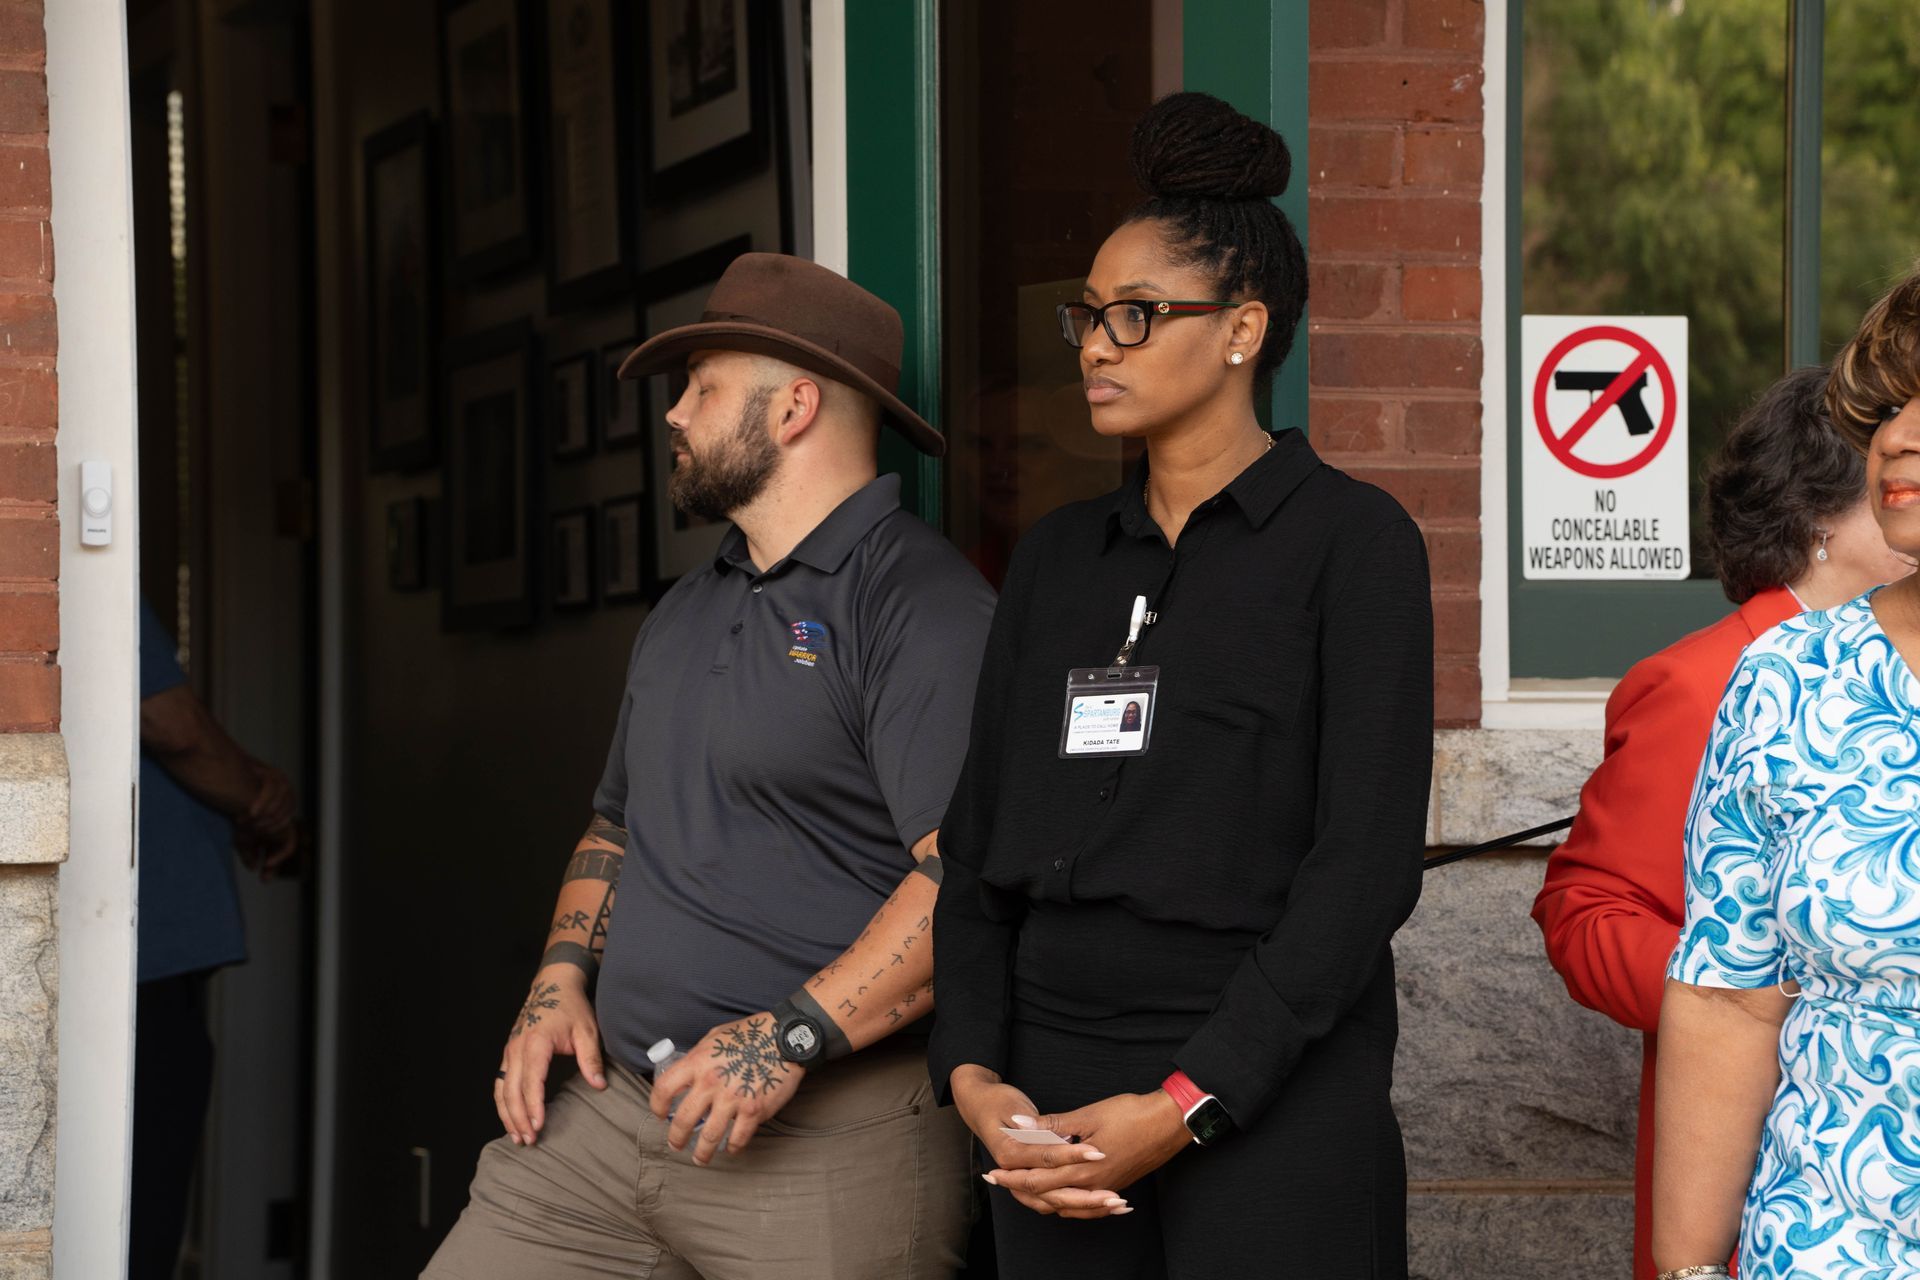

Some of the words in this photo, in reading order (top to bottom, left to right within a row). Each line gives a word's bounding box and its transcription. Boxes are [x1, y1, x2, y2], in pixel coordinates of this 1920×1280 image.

[1595, 490, 1616, 512] NO
[1552, 518, 1660, 541] CONCEALABLE
[1529, 547, 1605, 570] WEAPONS
[1609, 547, 1684, 570] ALLOWED
